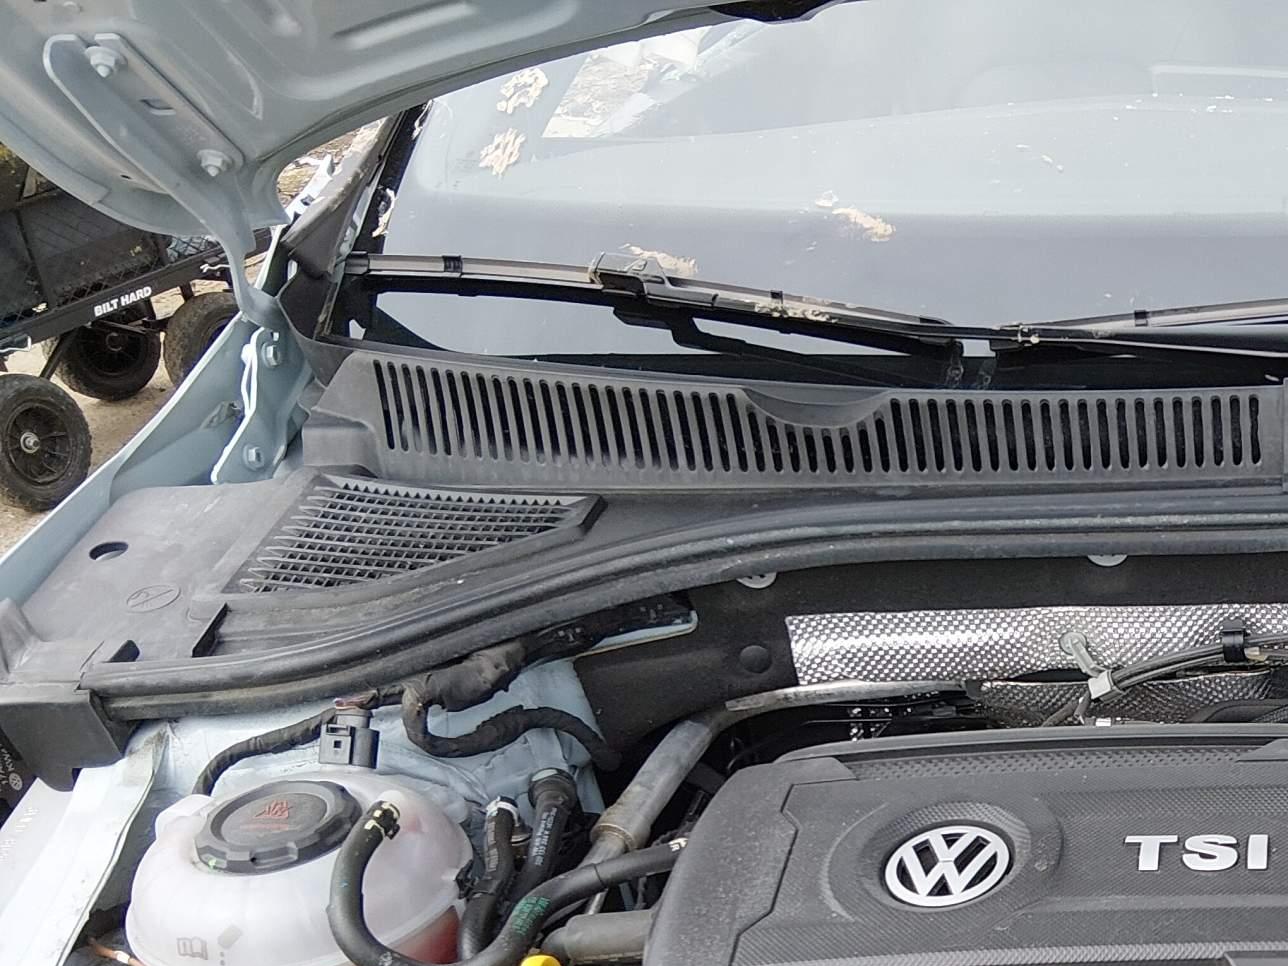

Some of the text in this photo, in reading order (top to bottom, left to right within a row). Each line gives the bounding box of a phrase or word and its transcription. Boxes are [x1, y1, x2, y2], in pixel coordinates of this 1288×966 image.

[94, 286, 153, 317] BILT HARD
[885, 825, 1010, 907] VW
[1124, 834, 1269, 871] TSI
